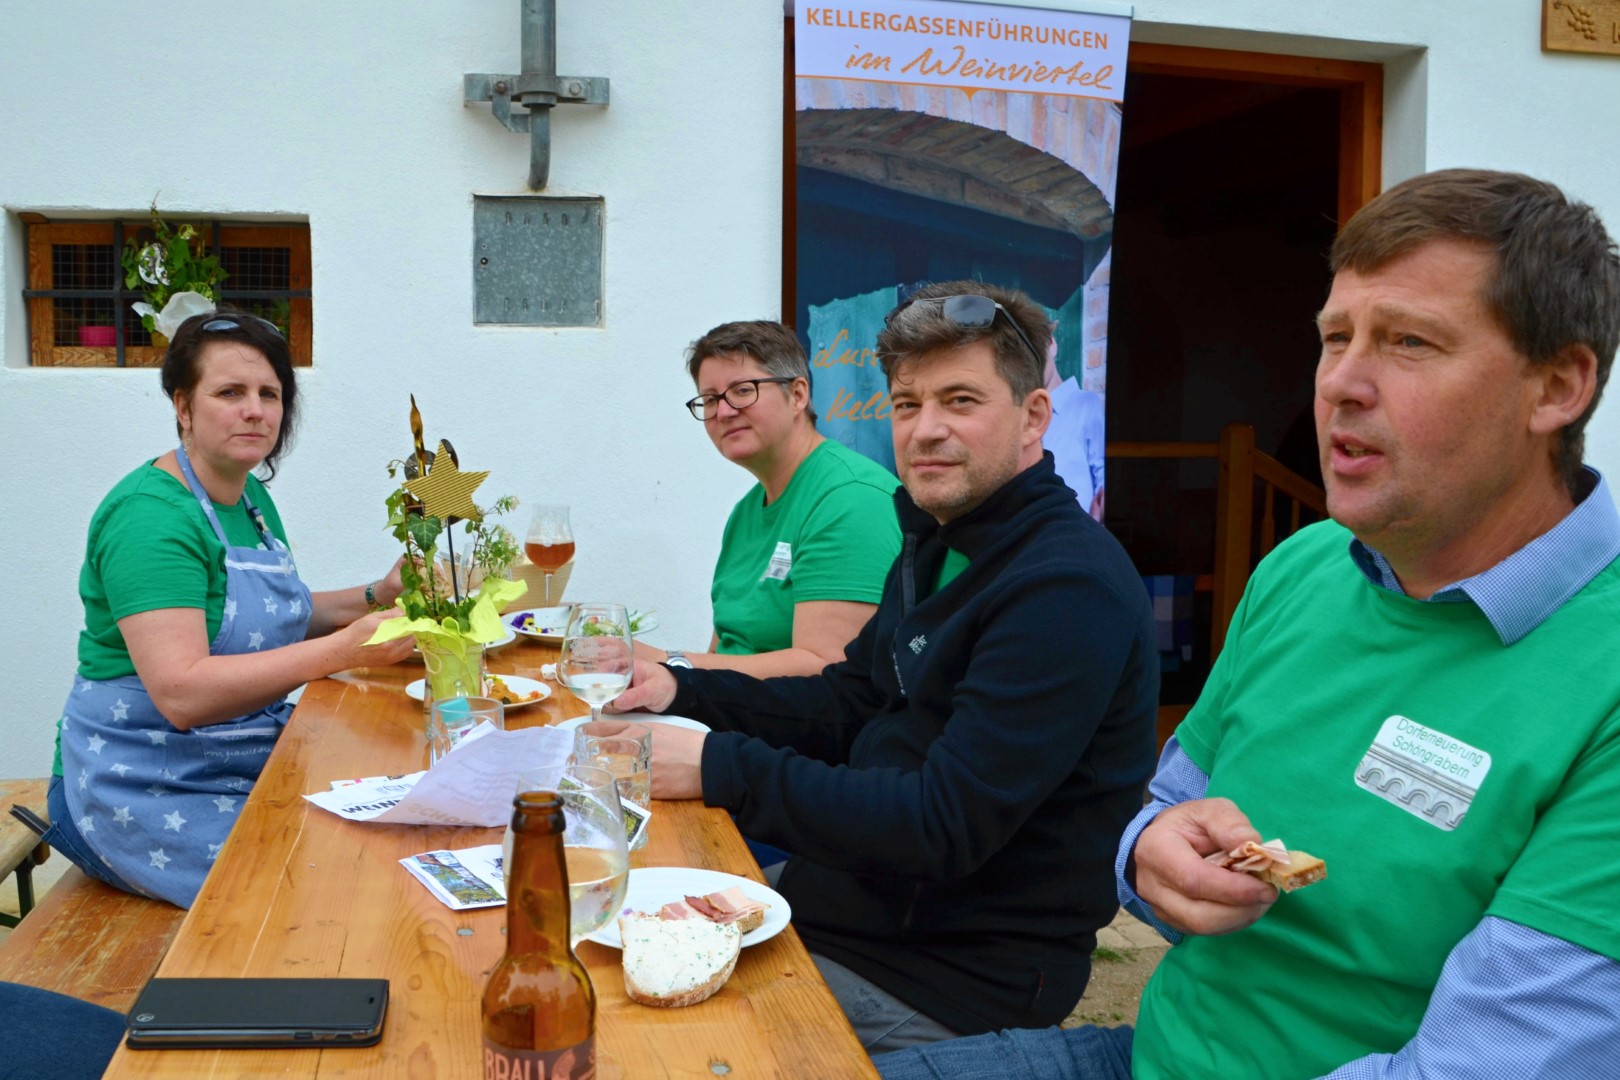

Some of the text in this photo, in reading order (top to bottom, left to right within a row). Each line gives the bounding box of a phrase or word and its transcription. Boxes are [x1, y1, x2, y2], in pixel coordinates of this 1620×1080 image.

[806, 7, 1108, 50] KELLERGASSENFÜHRUNGEN
[845, 45, 1113, 91] im Weinviertel
[826, 388, 892, 422] Kell
[1392, 735, 1470, 779] Schöngrabern
[1396, 718, 1483, 768] Dorferneuerung
